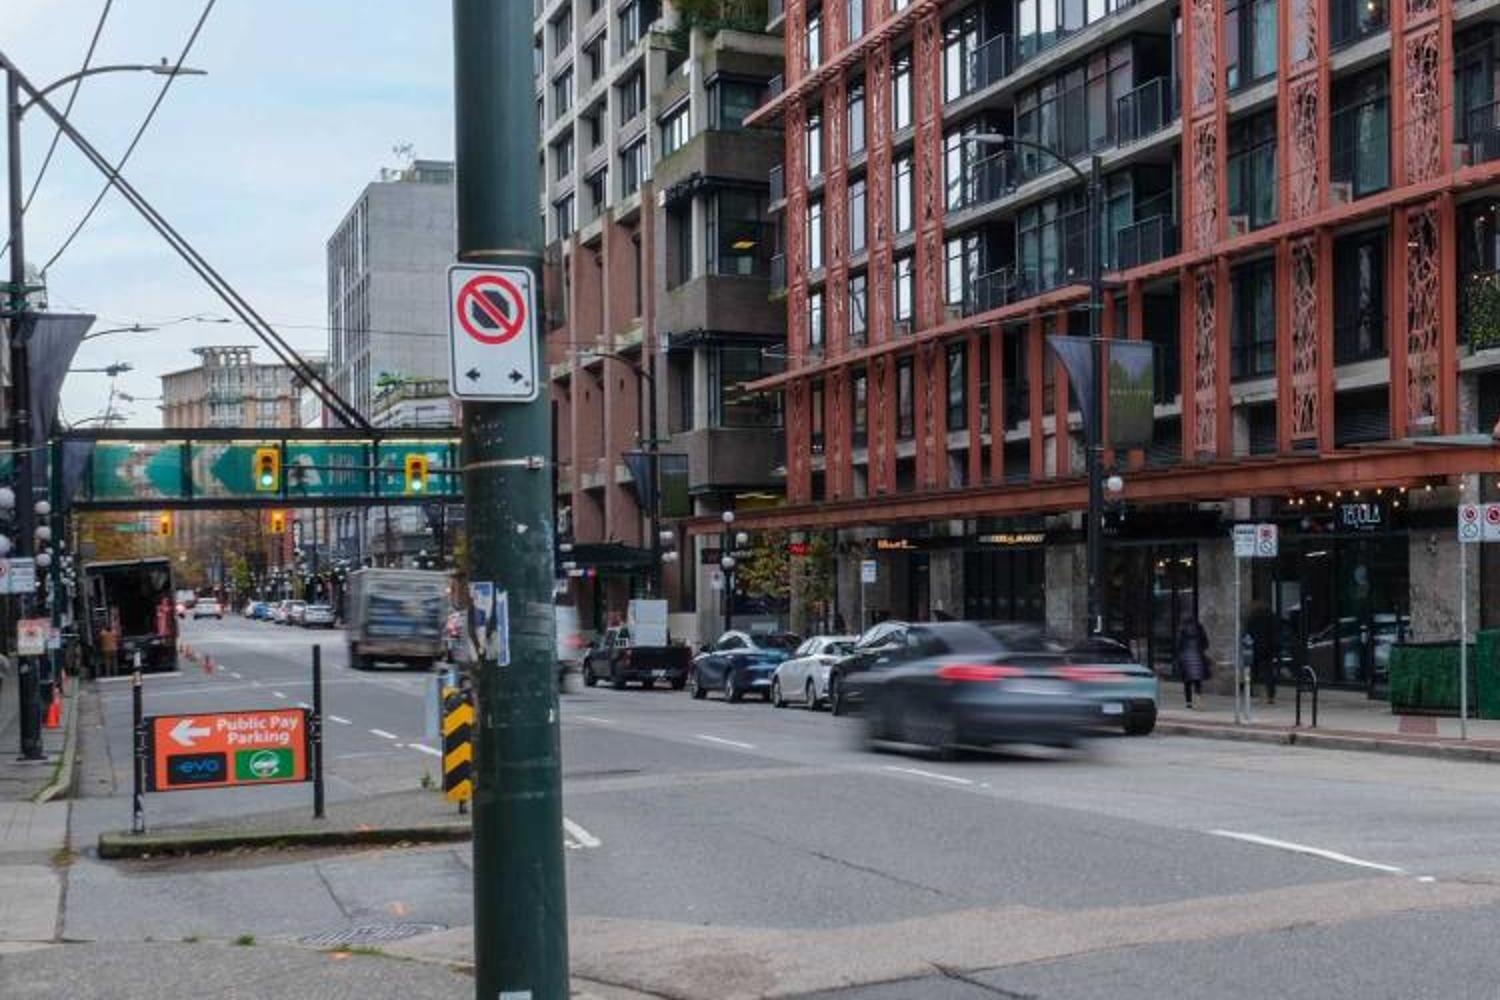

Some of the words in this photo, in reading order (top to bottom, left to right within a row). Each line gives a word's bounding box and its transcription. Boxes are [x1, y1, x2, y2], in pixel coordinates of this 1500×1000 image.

[217, 717, 266, 731] Public
[269, 714, 298, 729] Pay
[227, 732, 290, 745] Parking
[180, 759, 219, 773] evo
